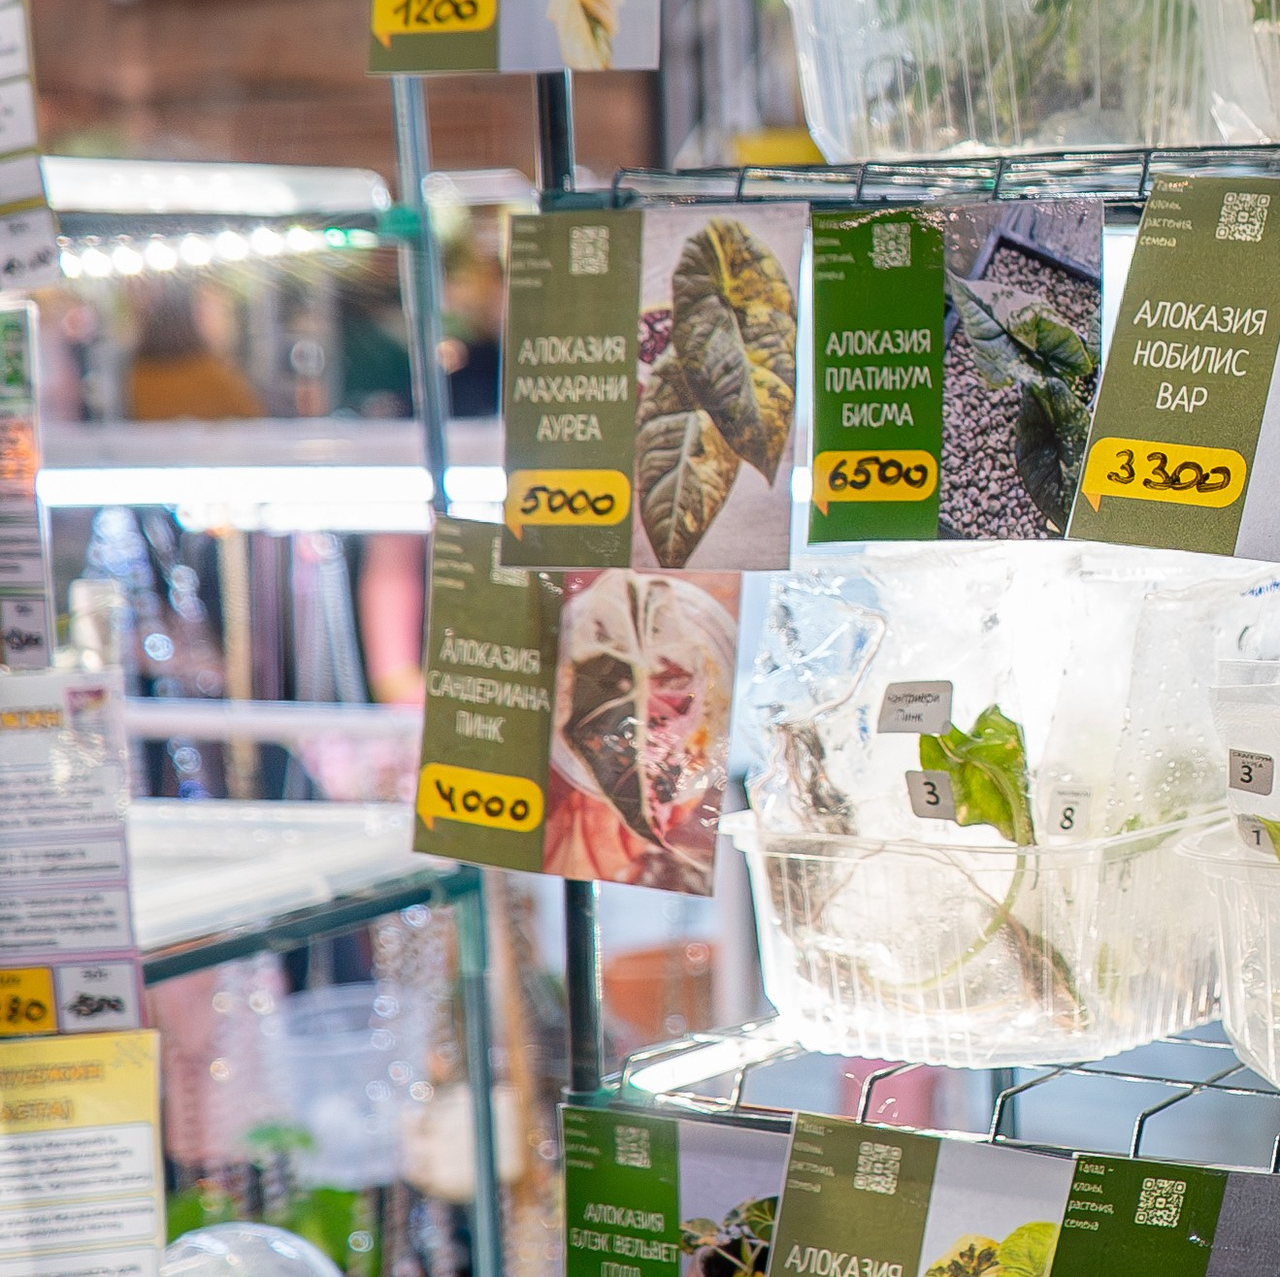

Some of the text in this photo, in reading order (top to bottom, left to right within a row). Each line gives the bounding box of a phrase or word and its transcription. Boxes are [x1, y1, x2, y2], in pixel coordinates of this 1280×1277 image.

[1133, 299, 1268, 336] АЛОКАЗИЯ
[518, 335, 627, 367] АЛОКАЗИЯ
[825, 328, 932, 357] АЛОКАЗИЯ
[1132, 339, 1250, 377] НОБИЛИС
[513, 373, 628, 403] МАХАРАНИ
[825, 366, 933, 393] ПЛАТИНУМ
[1155, 382, 1208, 413] ВАР
[536, 413, 602, 441] АУРЕА
[842, 403, 914, 428] БИСМА
[828, 456, 928, 492] 6500
[1106, 448, 1231, 493] 3300
[520, 485, 614, 515] 5000
[440, 637, 541, 675] АЛОКАЗИЯ
[455, 709, 506, 743] ПИНК
[1240, 765, 1253, 783] 3
[436, 778, 530, 822] 4000
[923, 781, 940, 806] 3
[1060, 807, 1075, 830] 8
[1252, 830, 1261, 846] 1
[583, 1202, 665, 1232] АЛОКАЗИЯ
[613, 1235, 679, 1264] ВЕЛЬВЕТ
